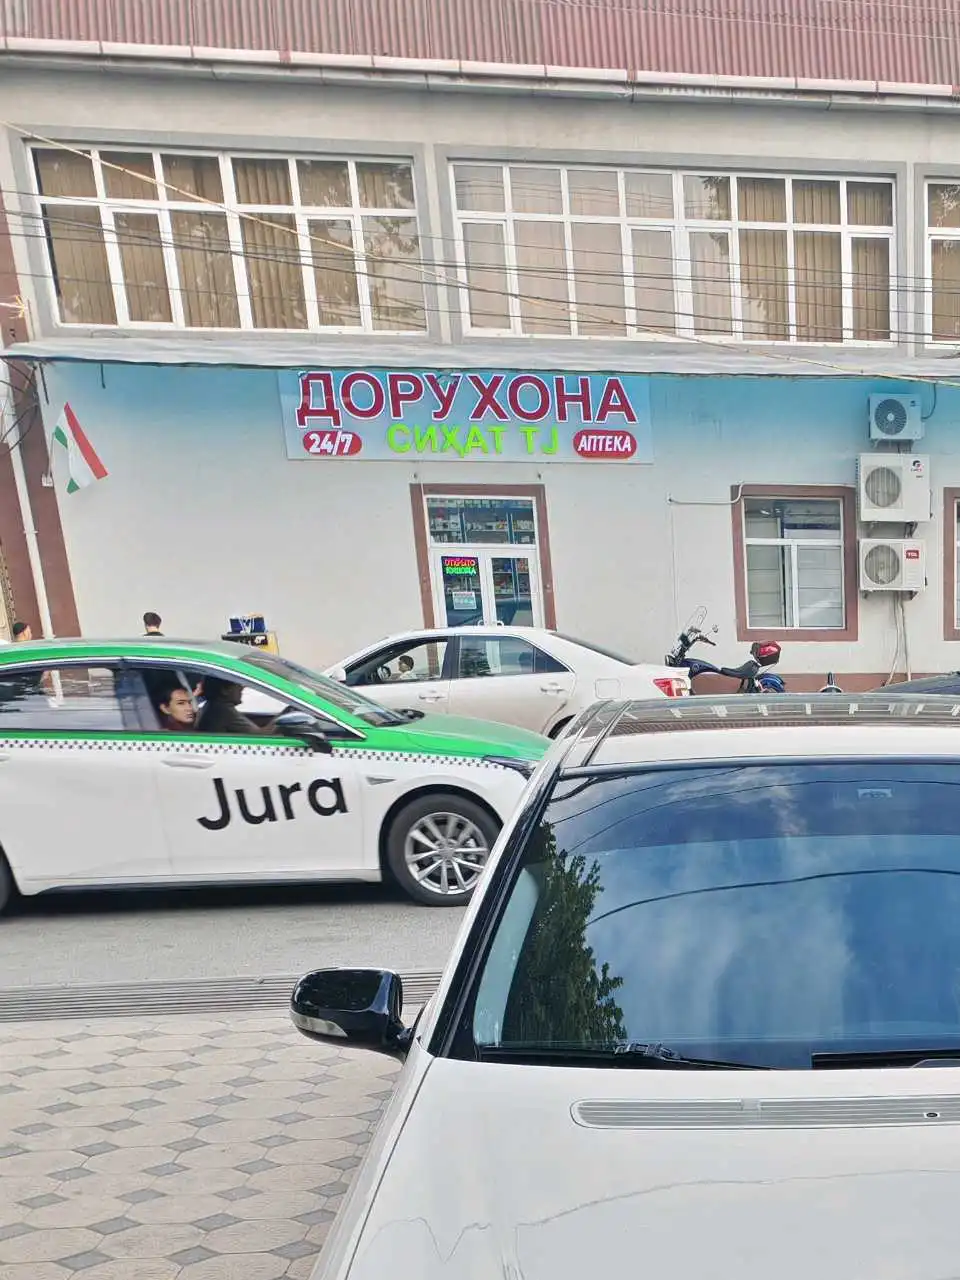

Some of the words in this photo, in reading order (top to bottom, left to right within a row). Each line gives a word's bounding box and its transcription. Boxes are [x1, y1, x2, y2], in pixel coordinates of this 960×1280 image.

[296, 371, 638, 428] ДОРУХОНА
[308, 431, 353, 455] 24/7
[577, 433, 633, 453] АПТЕКА
[197, 777, 349, 831] Jura
